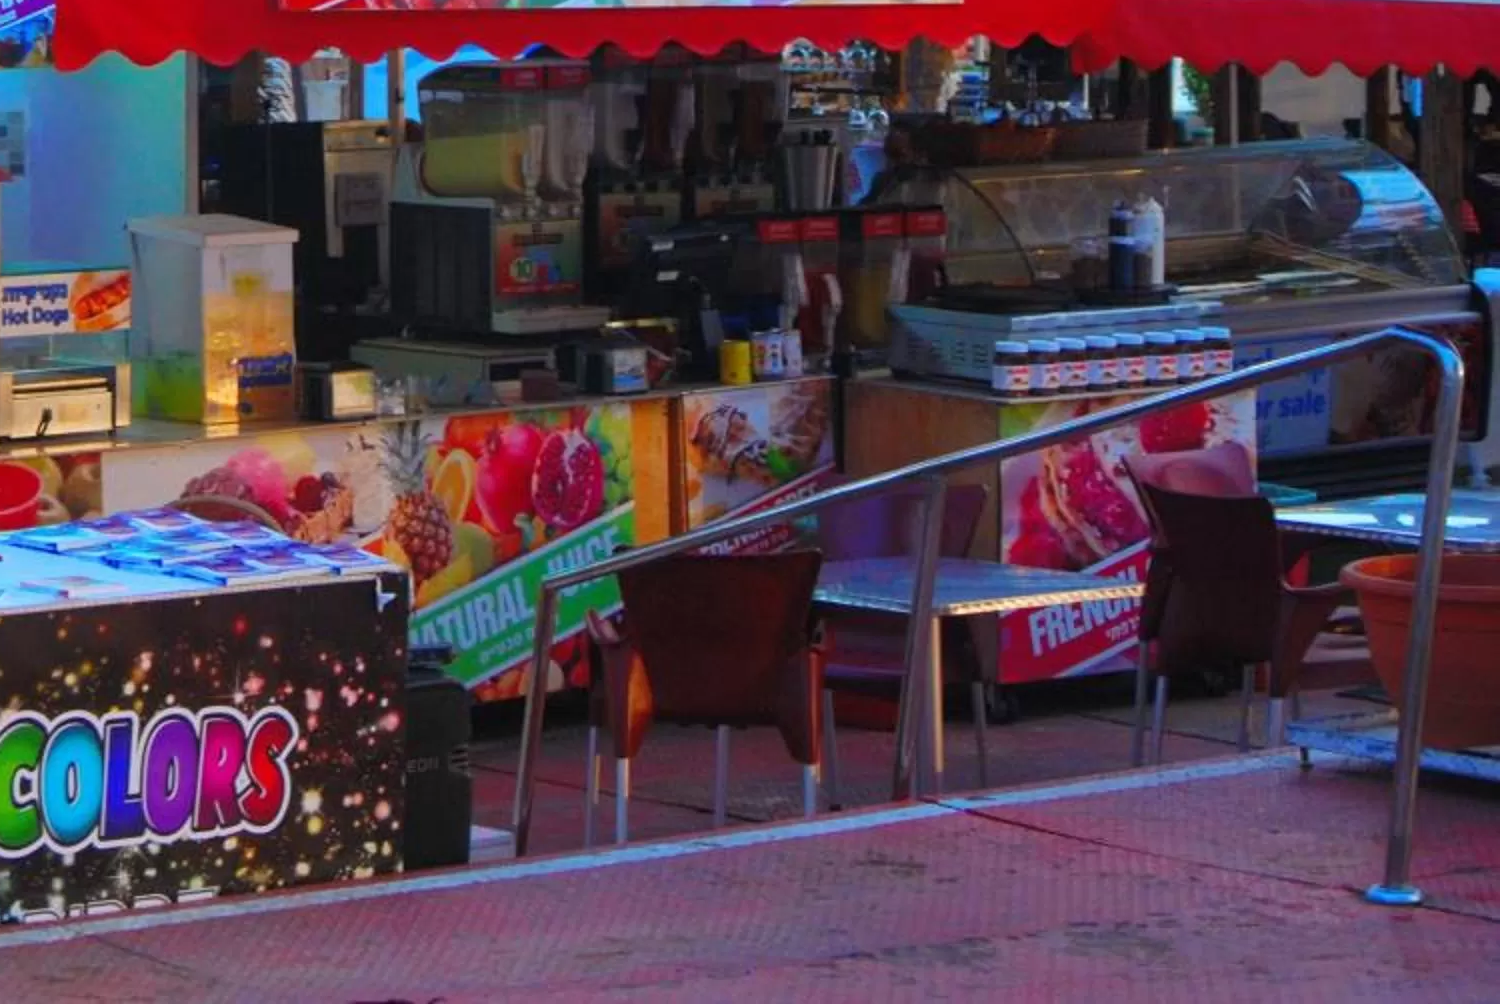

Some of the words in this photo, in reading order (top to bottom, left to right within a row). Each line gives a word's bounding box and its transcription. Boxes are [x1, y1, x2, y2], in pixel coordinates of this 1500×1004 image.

[1, 308, 29, 327] Hot
[32, 307, 69, 327] Dogs
[1278, 389, 1327, 419] sale
